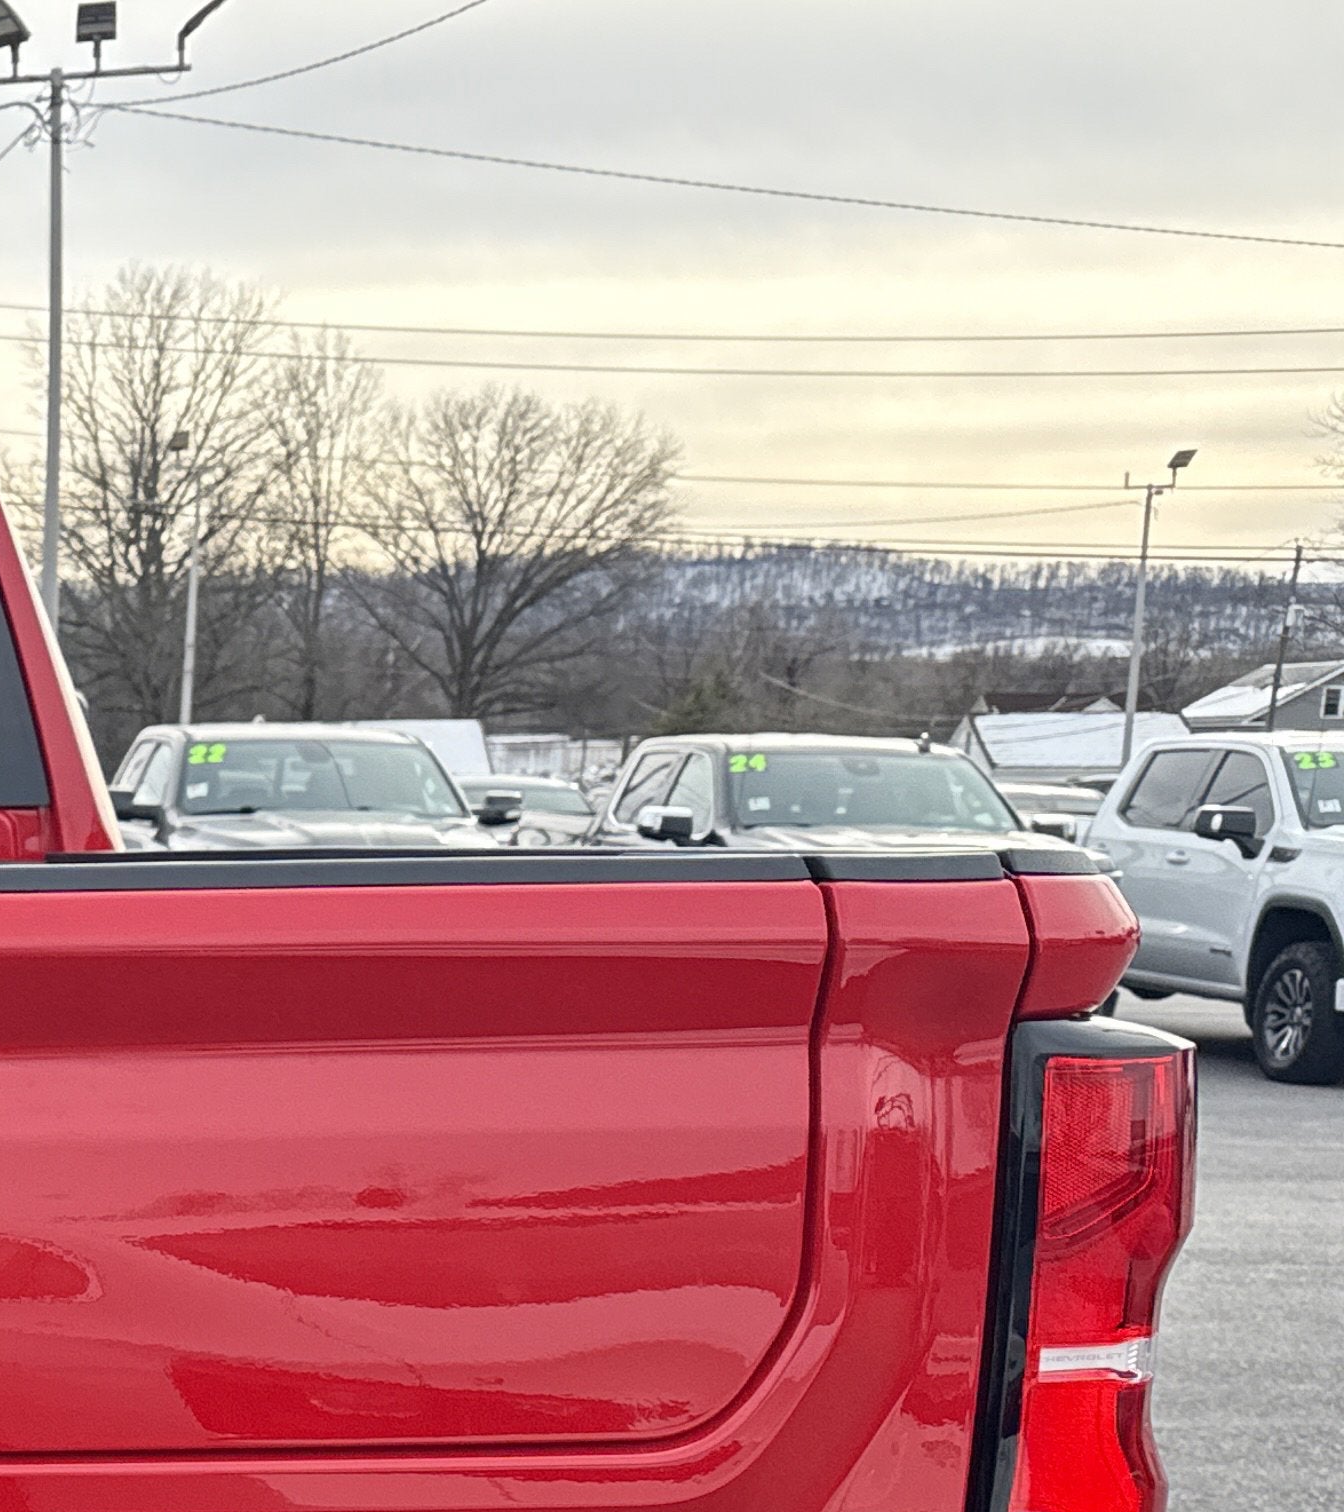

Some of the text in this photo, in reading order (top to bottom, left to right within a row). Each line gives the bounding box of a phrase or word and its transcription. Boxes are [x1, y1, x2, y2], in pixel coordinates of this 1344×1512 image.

[188, 743, 226, 764] 22
[1294, 752, 1336, 769] 23
[728, 754, 766, 772] 24
